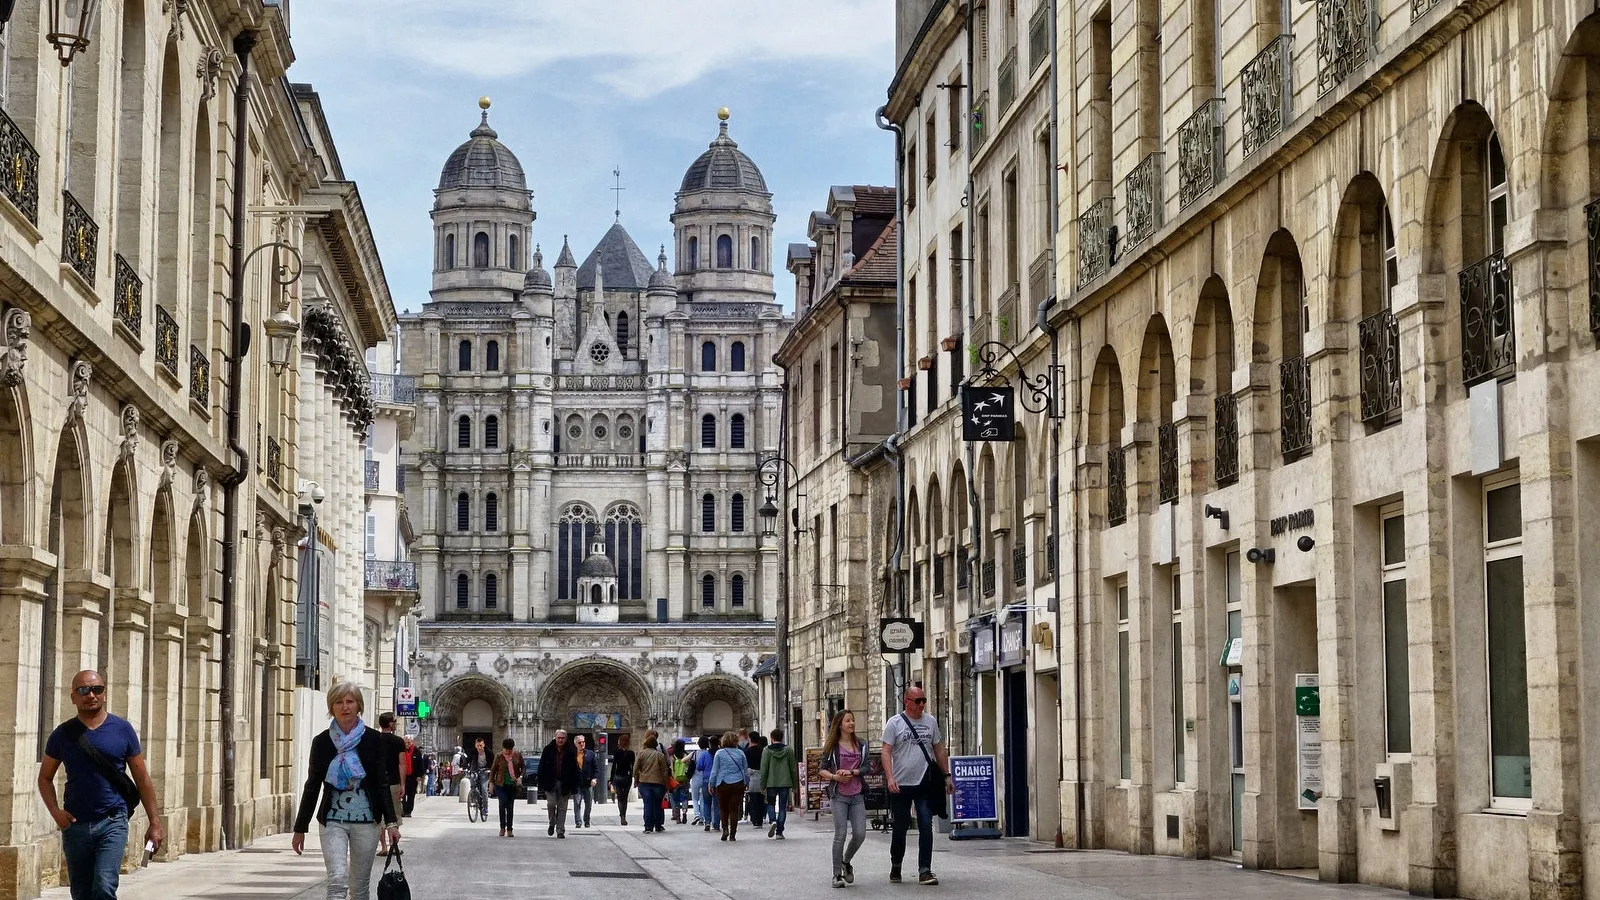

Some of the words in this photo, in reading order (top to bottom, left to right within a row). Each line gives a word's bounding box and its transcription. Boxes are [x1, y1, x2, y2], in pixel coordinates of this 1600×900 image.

[1270, 516, 1288, 537] BNP
[889, 627, 907, 635] grain
[954, 765, 992, 777] CHANGE
